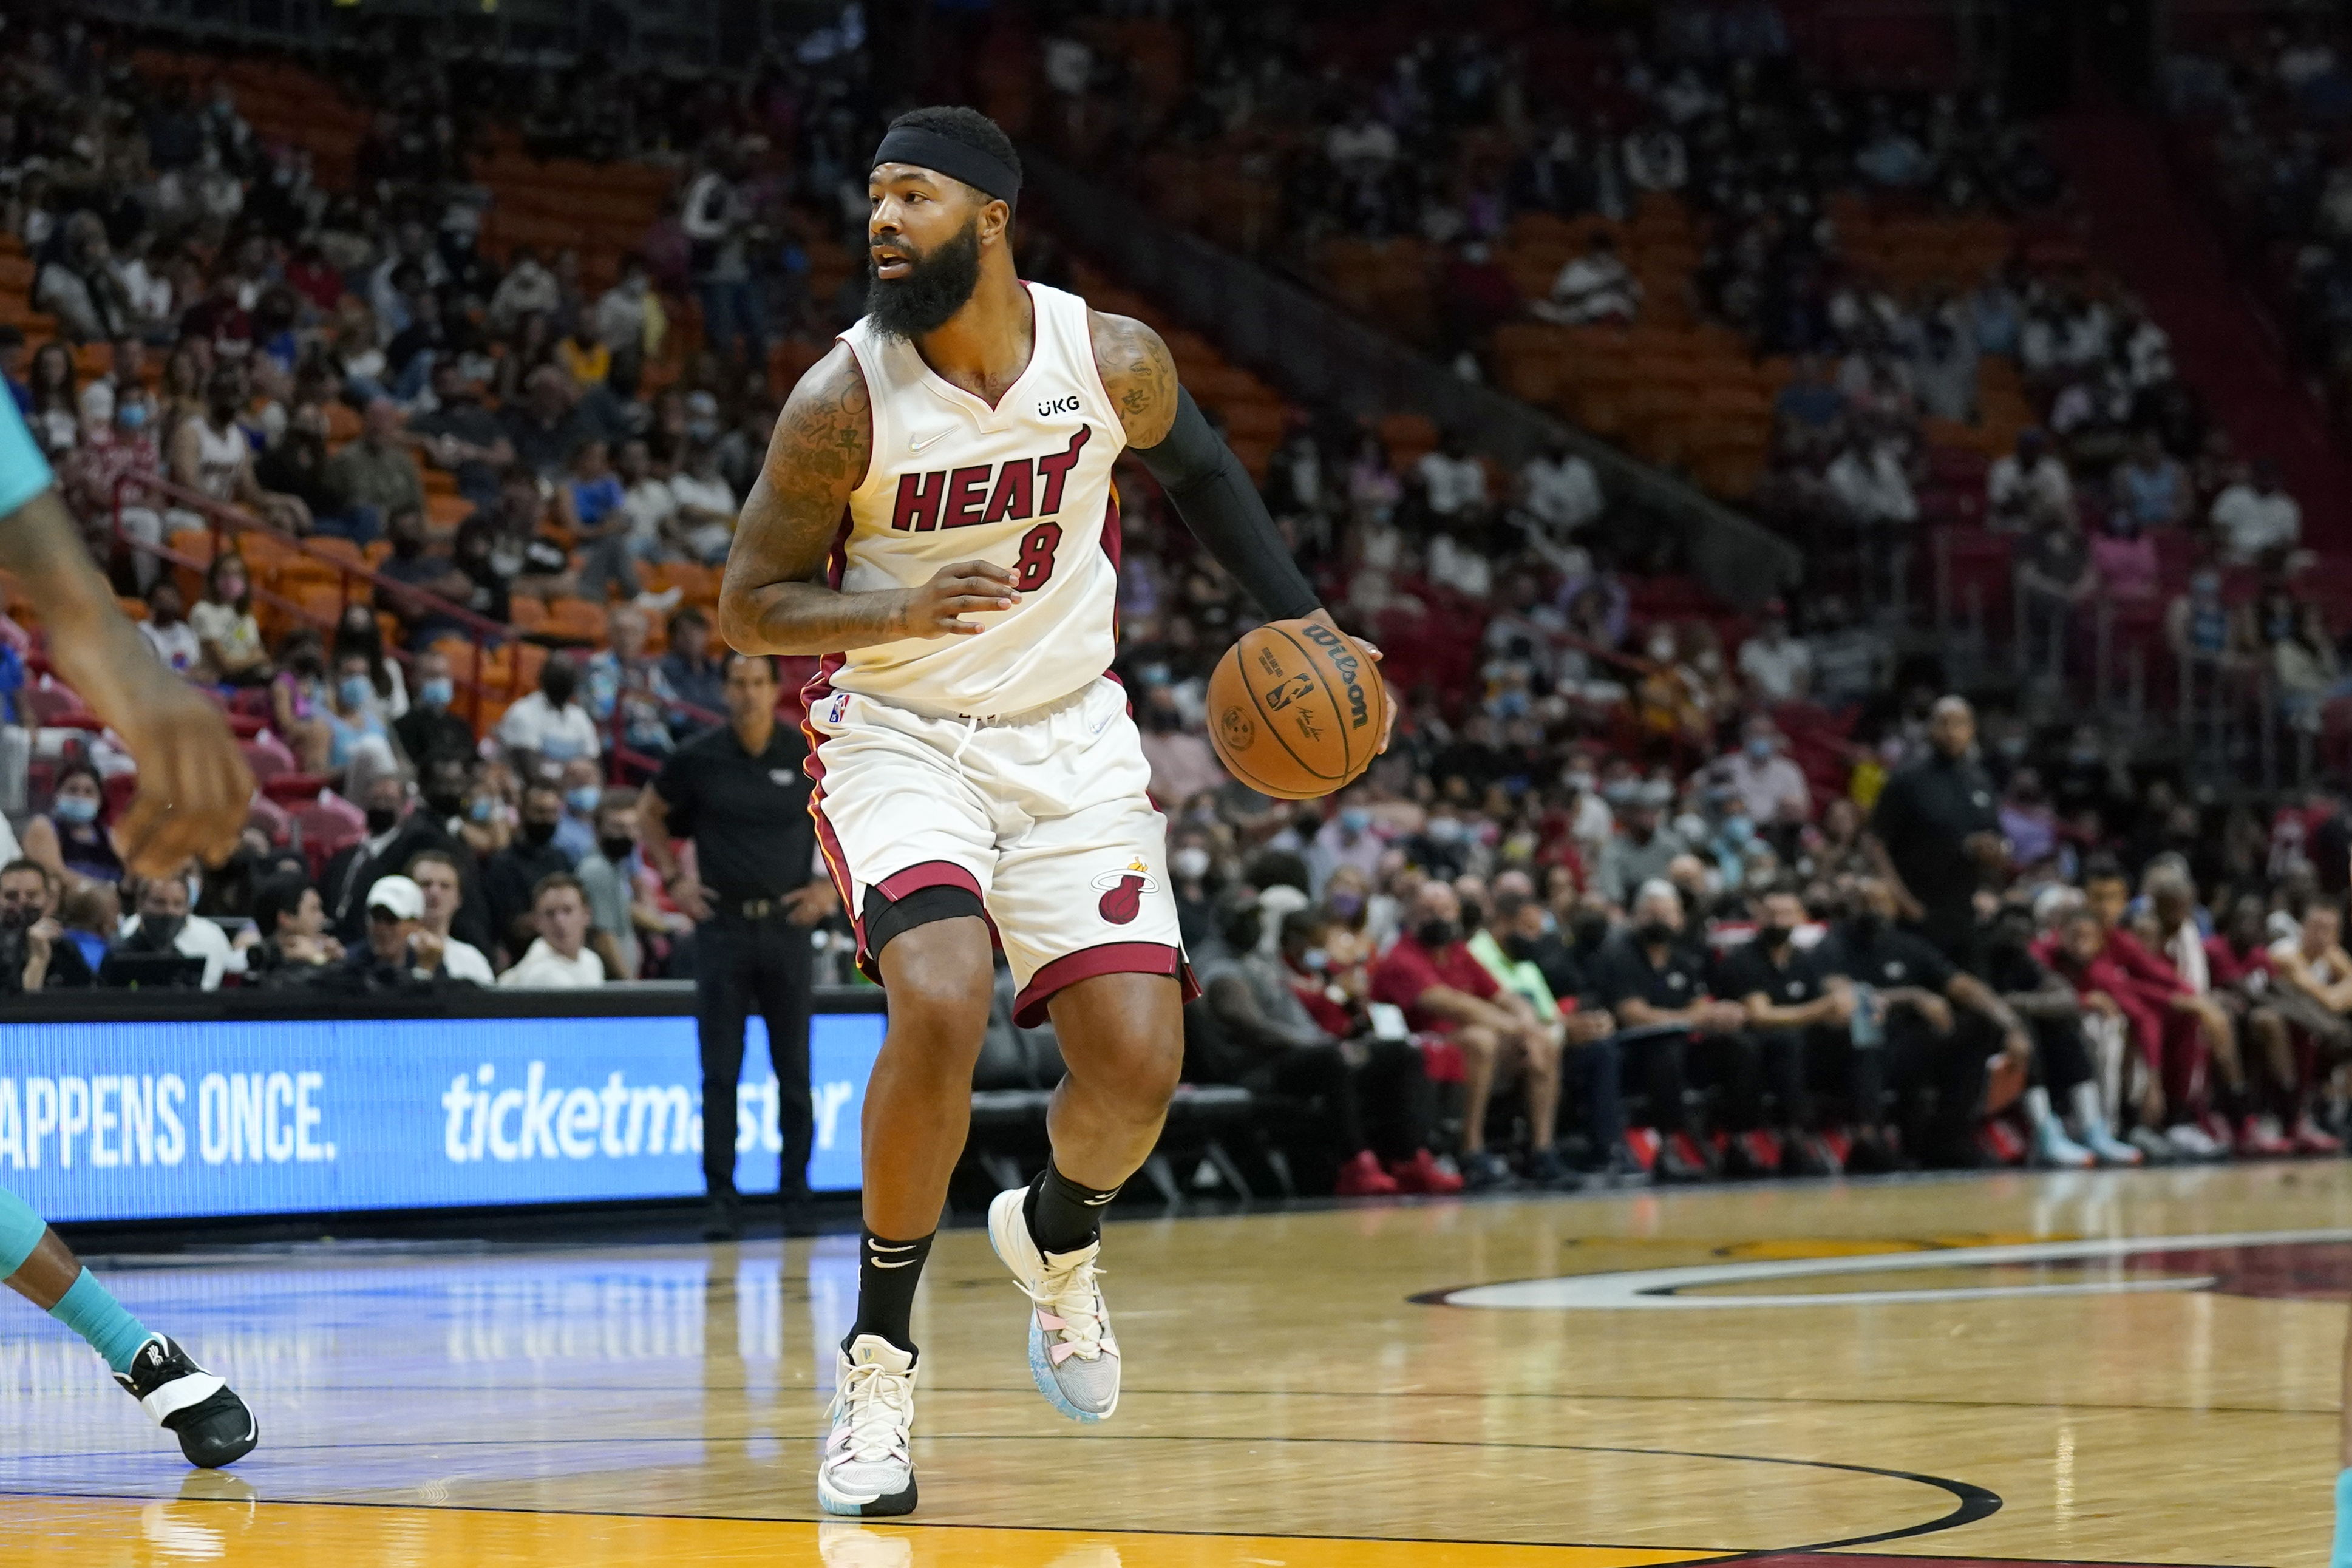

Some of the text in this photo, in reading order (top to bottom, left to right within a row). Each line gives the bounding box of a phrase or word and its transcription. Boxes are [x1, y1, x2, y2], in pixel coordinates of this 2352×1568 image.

[891, 423, 1092, 532] HEAT
[1013, 521, 1063, 592] 8
[1302, 624, 1368, 730] Wilson
[199, 1070, 338, 1166] ONCE.
[442, 1061, 852, 1162] ticketmstr
